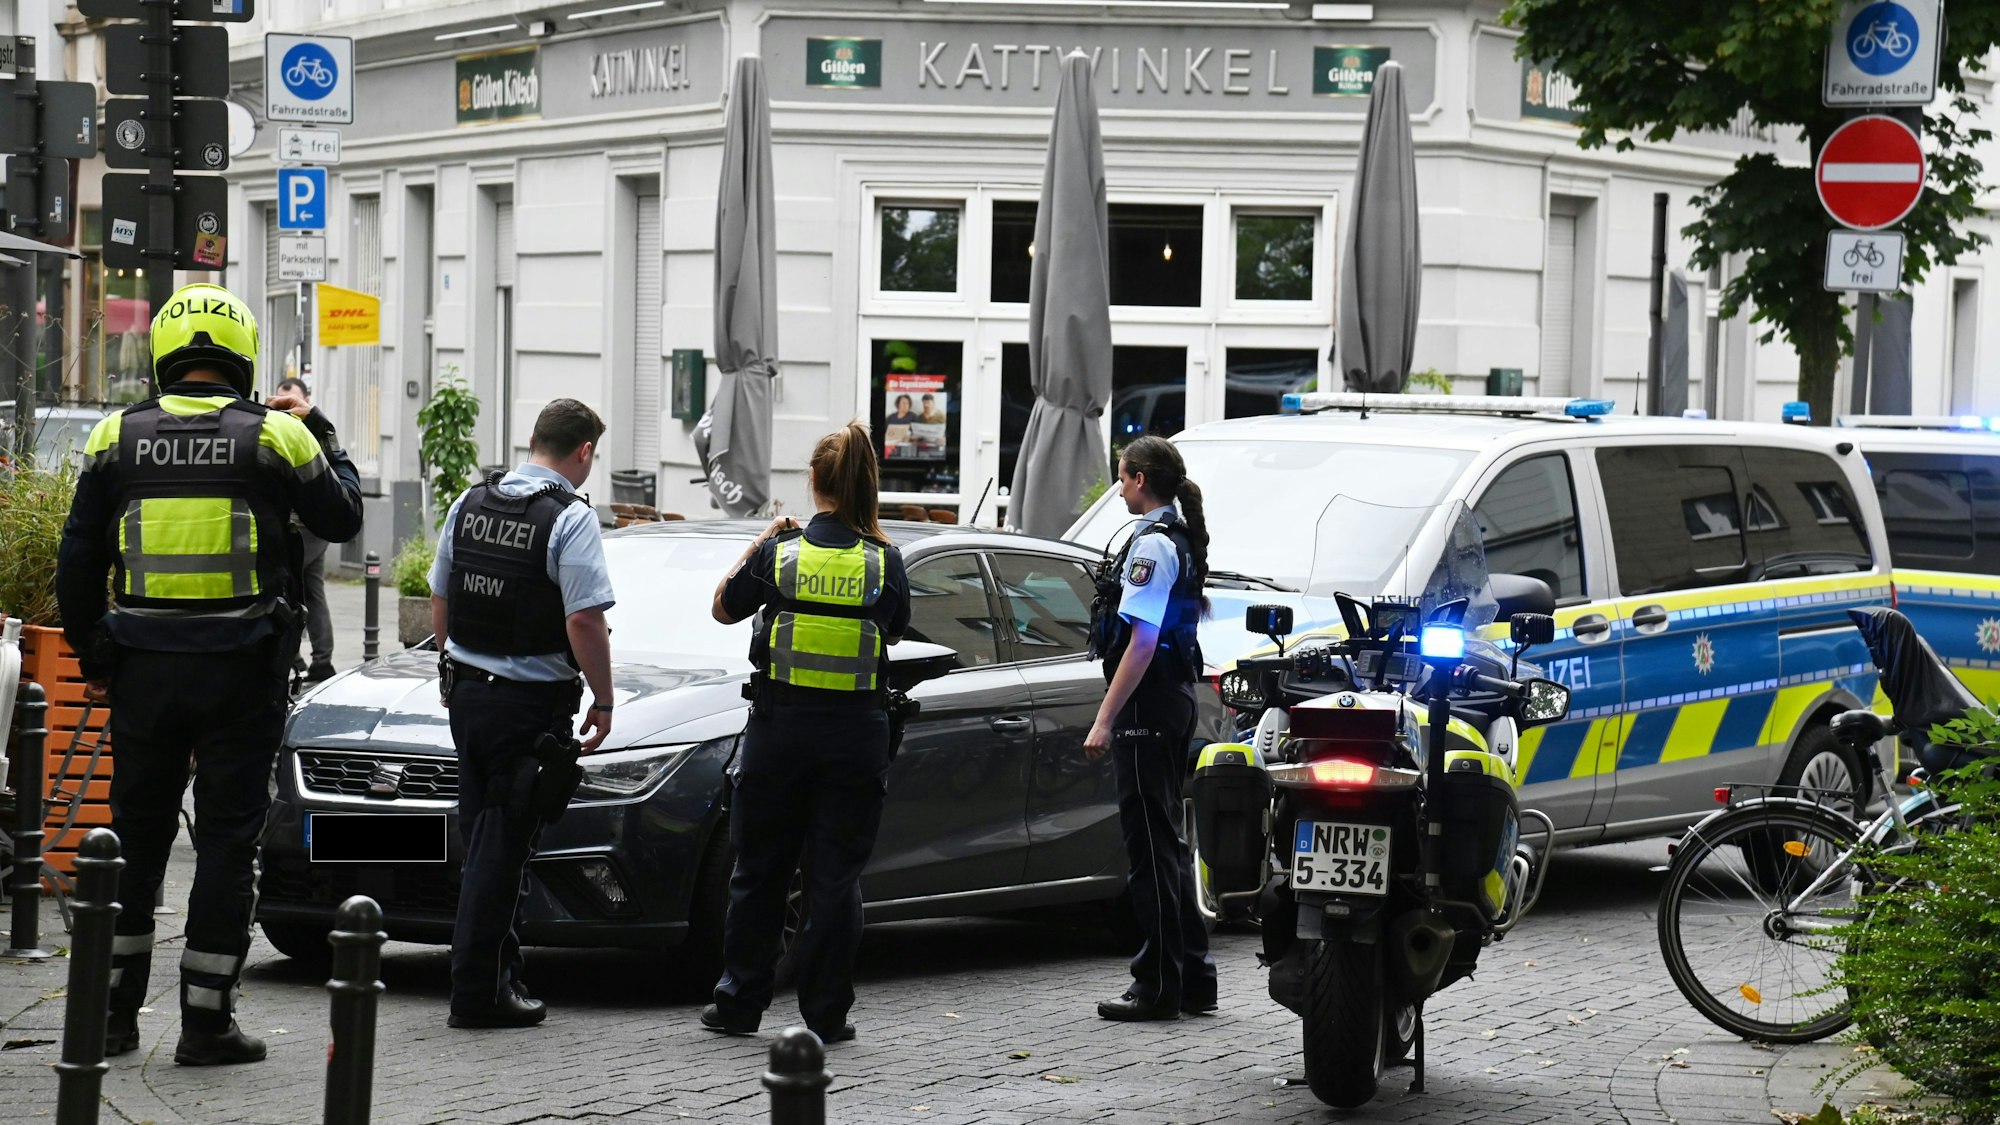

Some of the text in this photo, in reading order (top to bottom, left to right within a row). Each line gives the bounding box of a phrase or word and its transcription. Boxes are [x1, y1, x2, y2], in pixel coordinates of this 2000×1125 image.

[590, 44, 691, 98] KATTWINKEL
[821, 59, 866, 75] Gilden
[1328, 67, 1373, 83] Gilden
[472, 67, 538, 110] Gilden Kölsch
[1831, 82, 1927, 97] Fahrradstraße
[271, 103, 348, 118] Fahrradstraße
[311, 139, 336, 153] frei
[289, 175, 315, 222] P
[296, 241, 308, 250] mit
[281, 253, 324, 264] Parkschein
[1850, 270, 1874, 285] frei
[160, 298, 245, 328] POLIZEI
[329, 309, 366, 317] DHL
[136, 438, 236, 466] POLIZEI
[461, 512, 536, 550] POLIZEI
[463, 572, 505, 597] NRW
[797, 573, 863, 598] POLIZEI
[1125, 729, 1149, 737] POLIZEI
[1300, 825, 1370, 856] D NRW
[1296, 856, 1384, 890] 5-334
